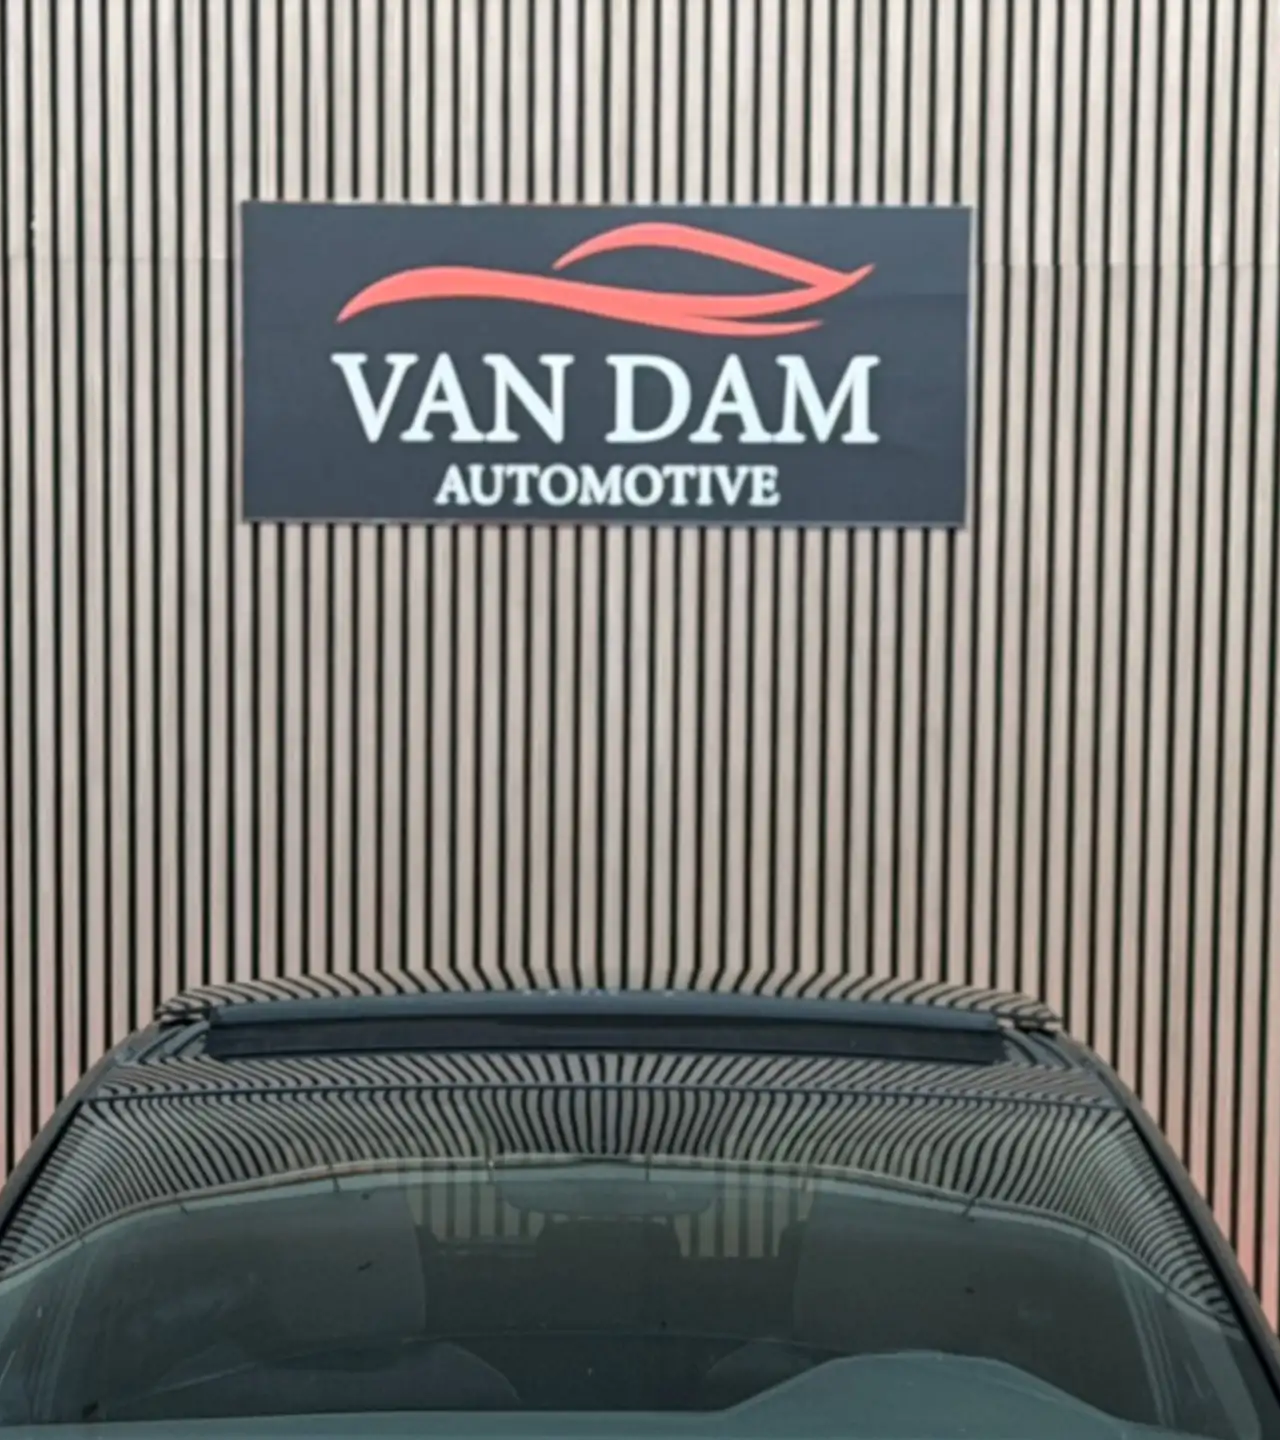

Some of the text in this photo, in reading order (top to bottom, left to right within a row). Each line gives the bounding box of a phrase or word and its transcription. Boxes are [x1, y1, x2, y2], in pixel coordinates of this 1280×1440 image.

[331, 352, 881, 444] VAN DAM
[434, 463, 781, 507] AUTOMOTIVE
